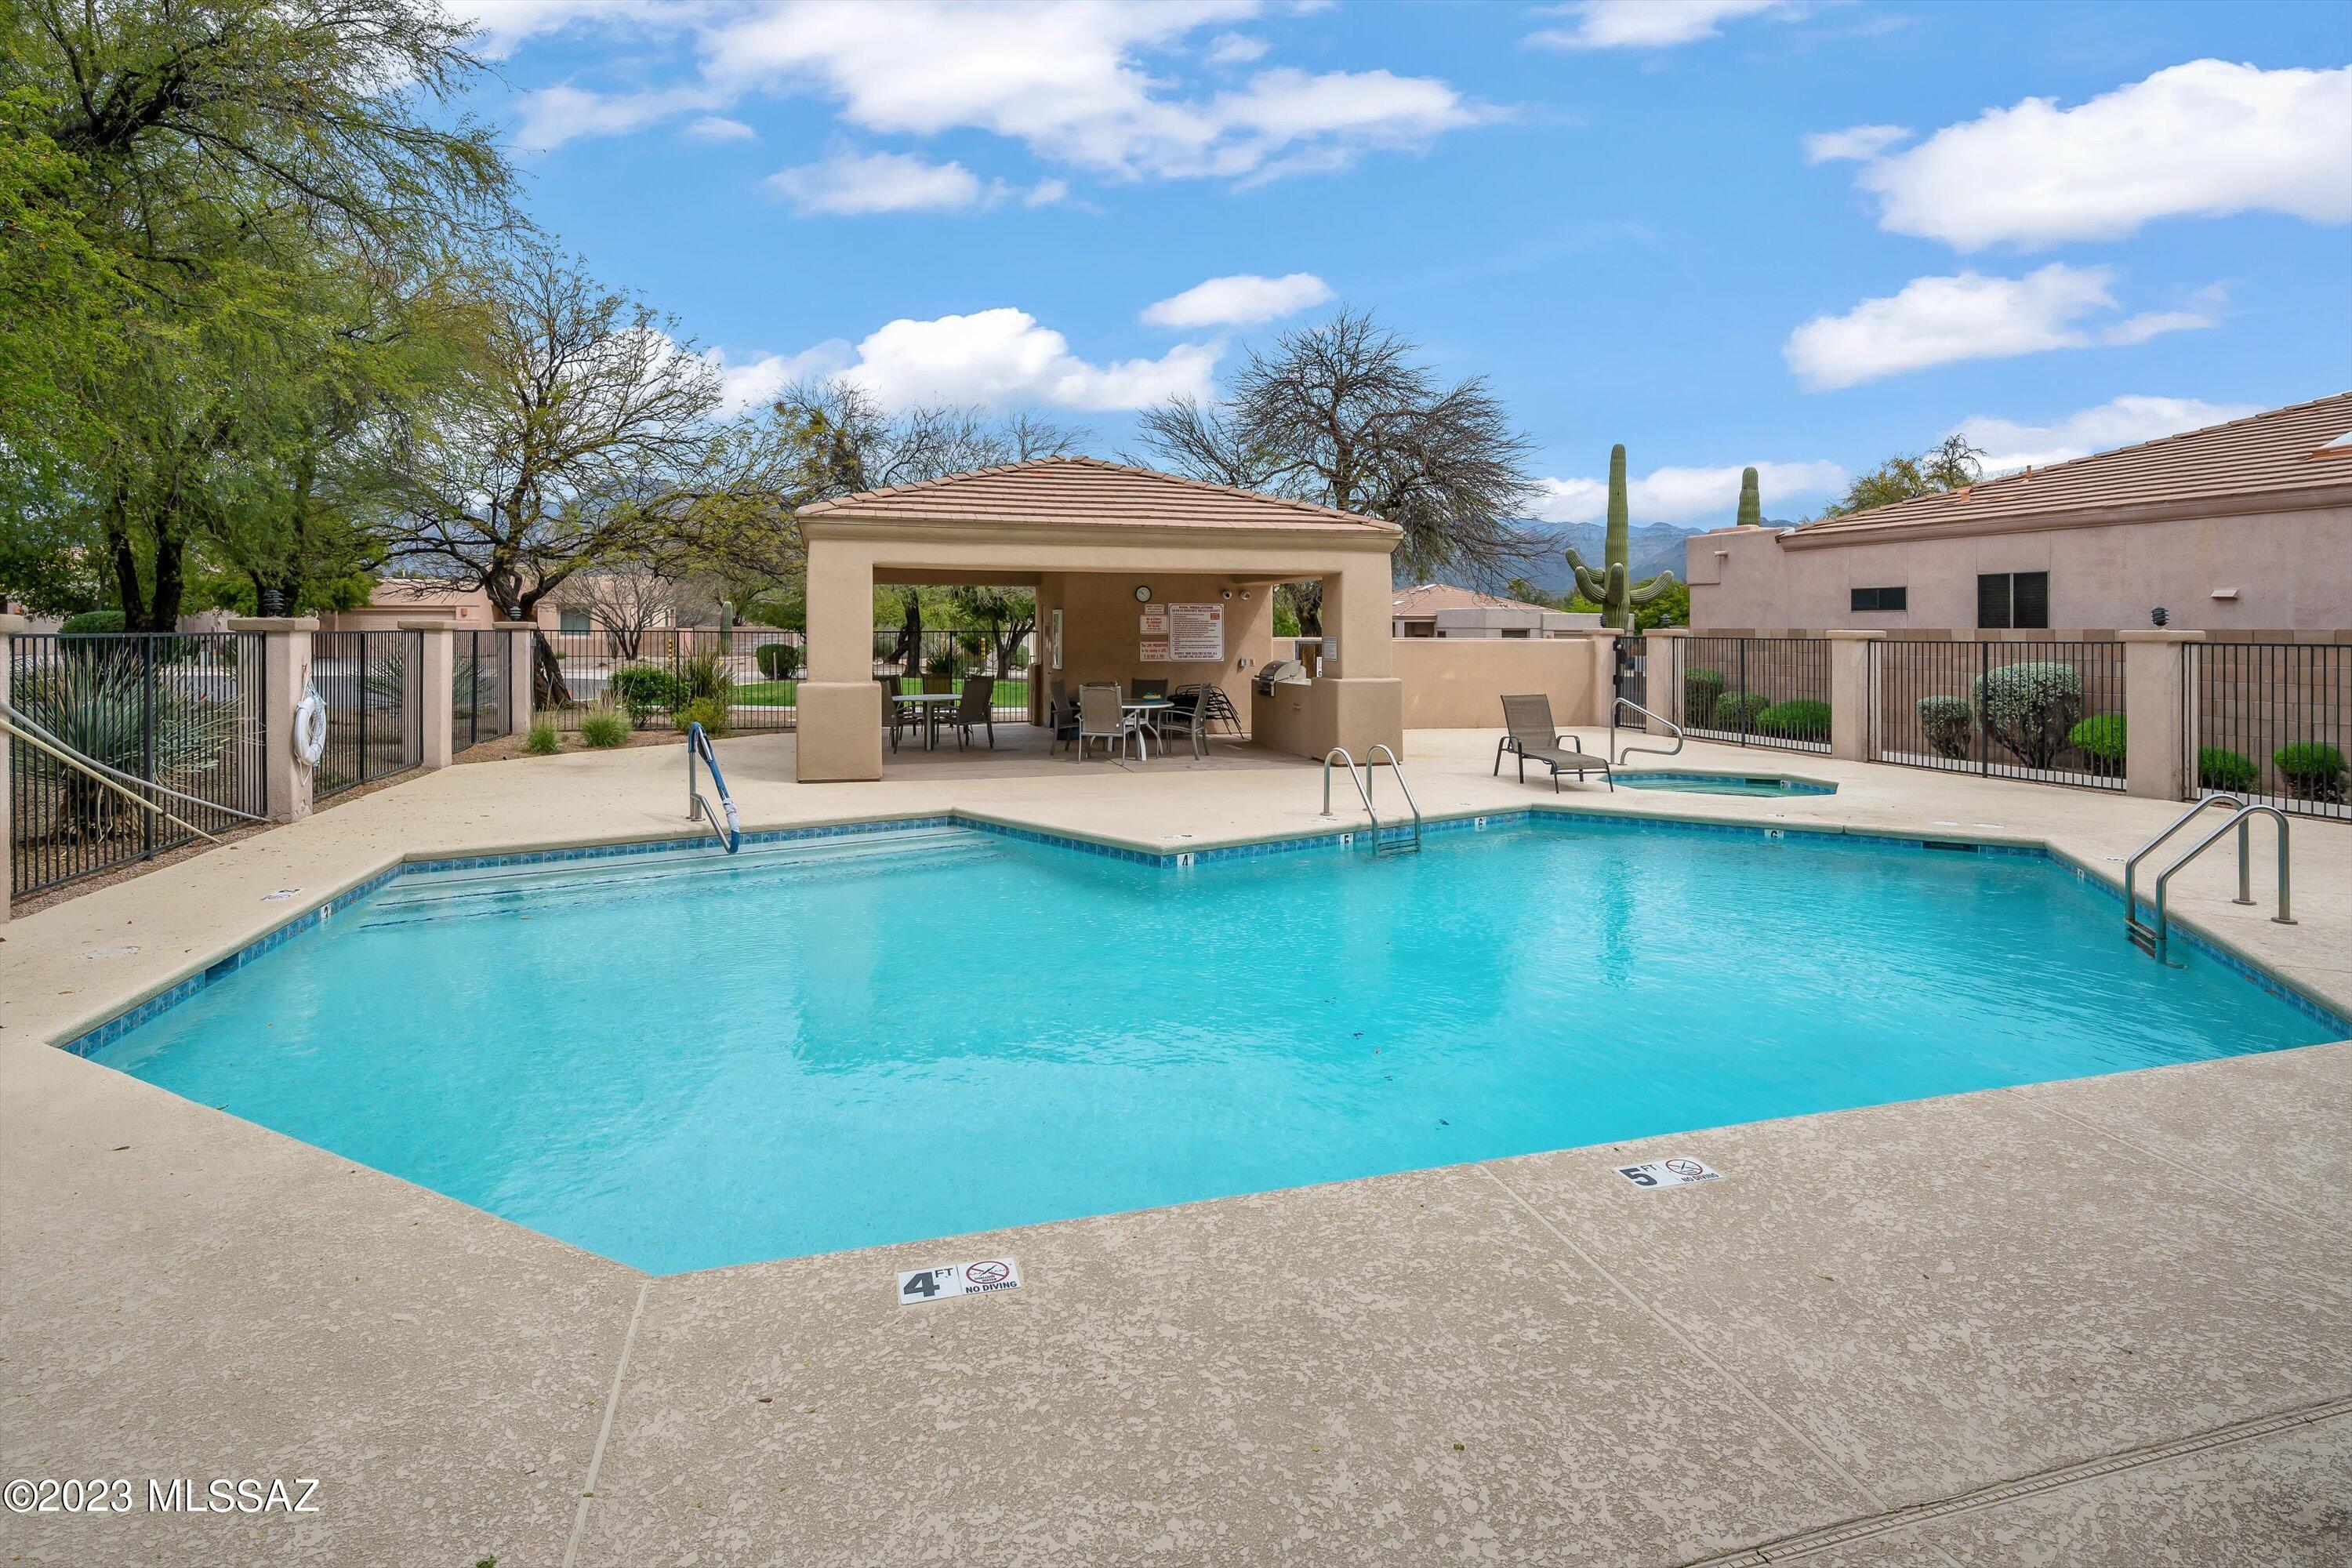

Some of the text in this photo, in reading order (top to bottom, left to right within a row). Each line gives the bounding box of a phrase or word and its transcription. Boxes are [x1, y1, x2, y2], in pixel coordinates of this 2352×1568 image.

[1619, 1163, 1657, 1186] 5 FT
[1692, 1172, 1719, 1181] DIVING
[903, 1267, 953, 1298] 4 FT
[965, 1280, 1018, 1294] NO DIVING
